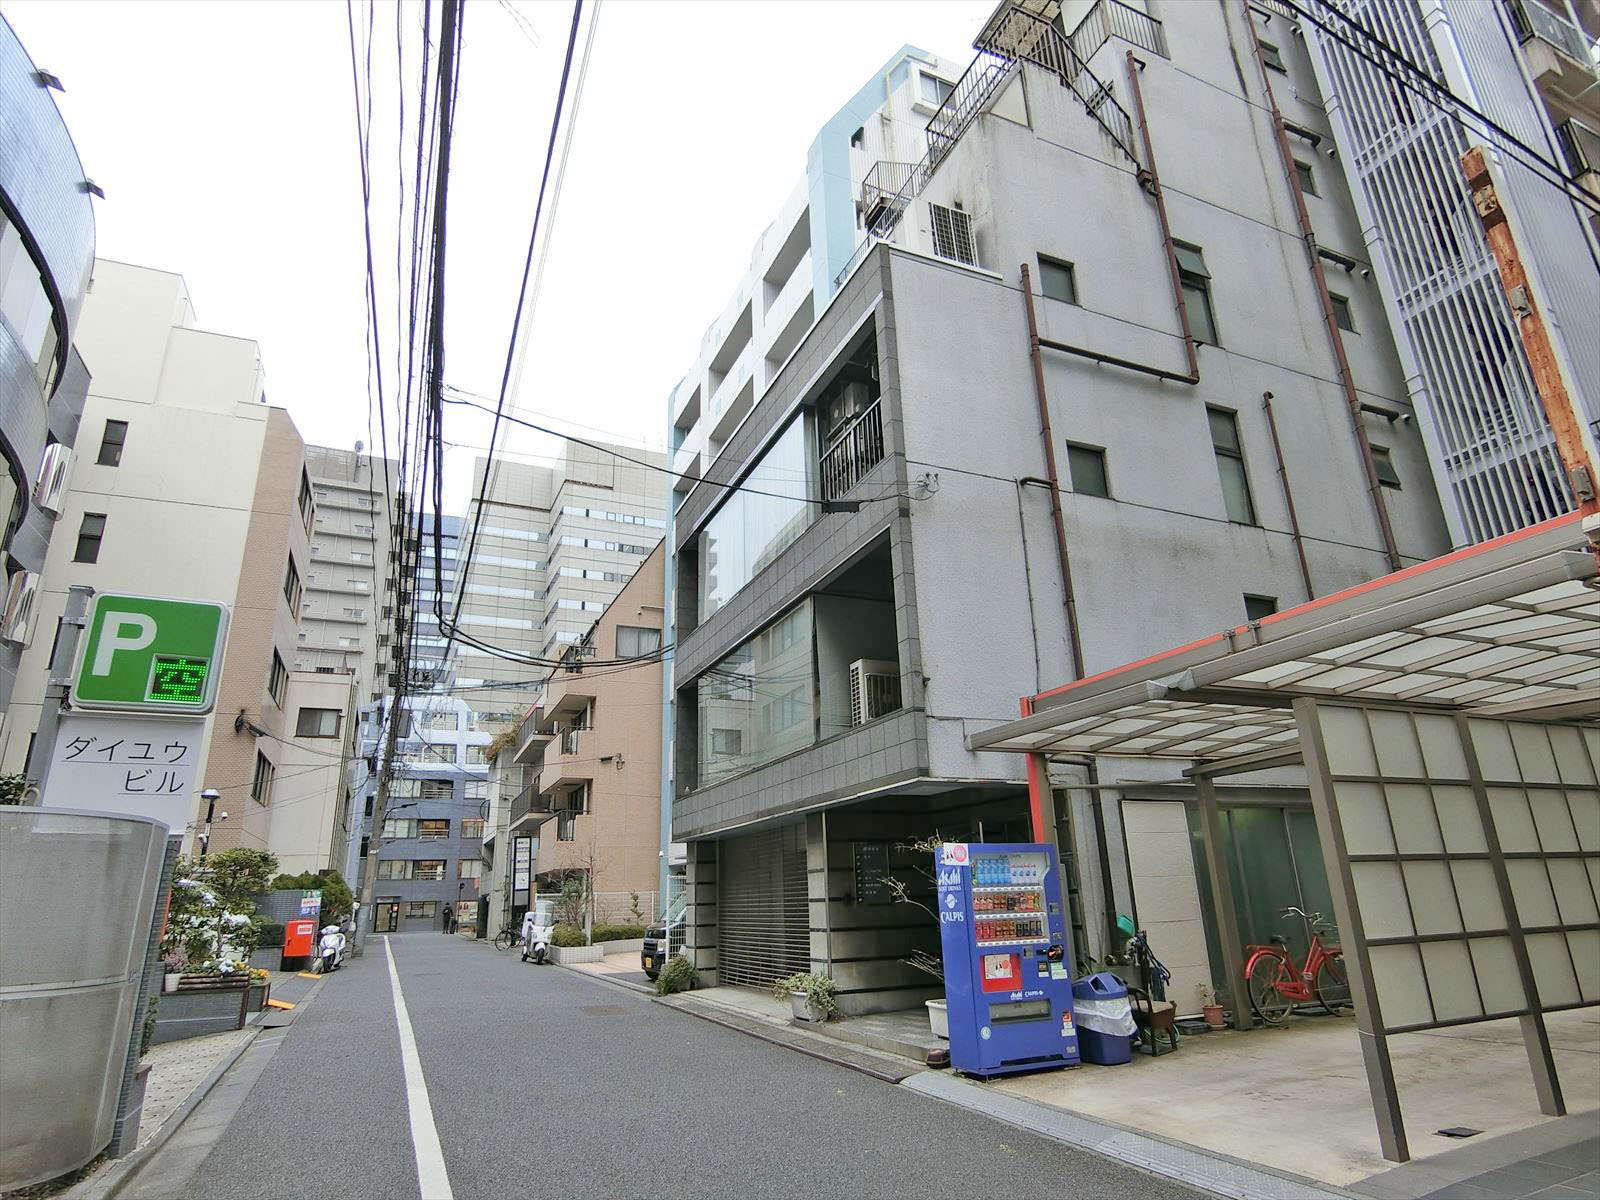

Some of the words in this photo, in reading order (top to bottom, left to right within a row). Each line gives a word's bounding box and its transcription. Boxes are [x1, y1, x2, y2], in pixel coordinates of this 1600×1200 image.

[92, 611, 157, 676] P
[150, 658, 207, 703] 空
[65, 736, 188, 762] ダイユウ
[124, 768, 184, 794] ビル
[938, 868, 961, 886] Asahi
[940, 911, 964, 924] CALPIS
